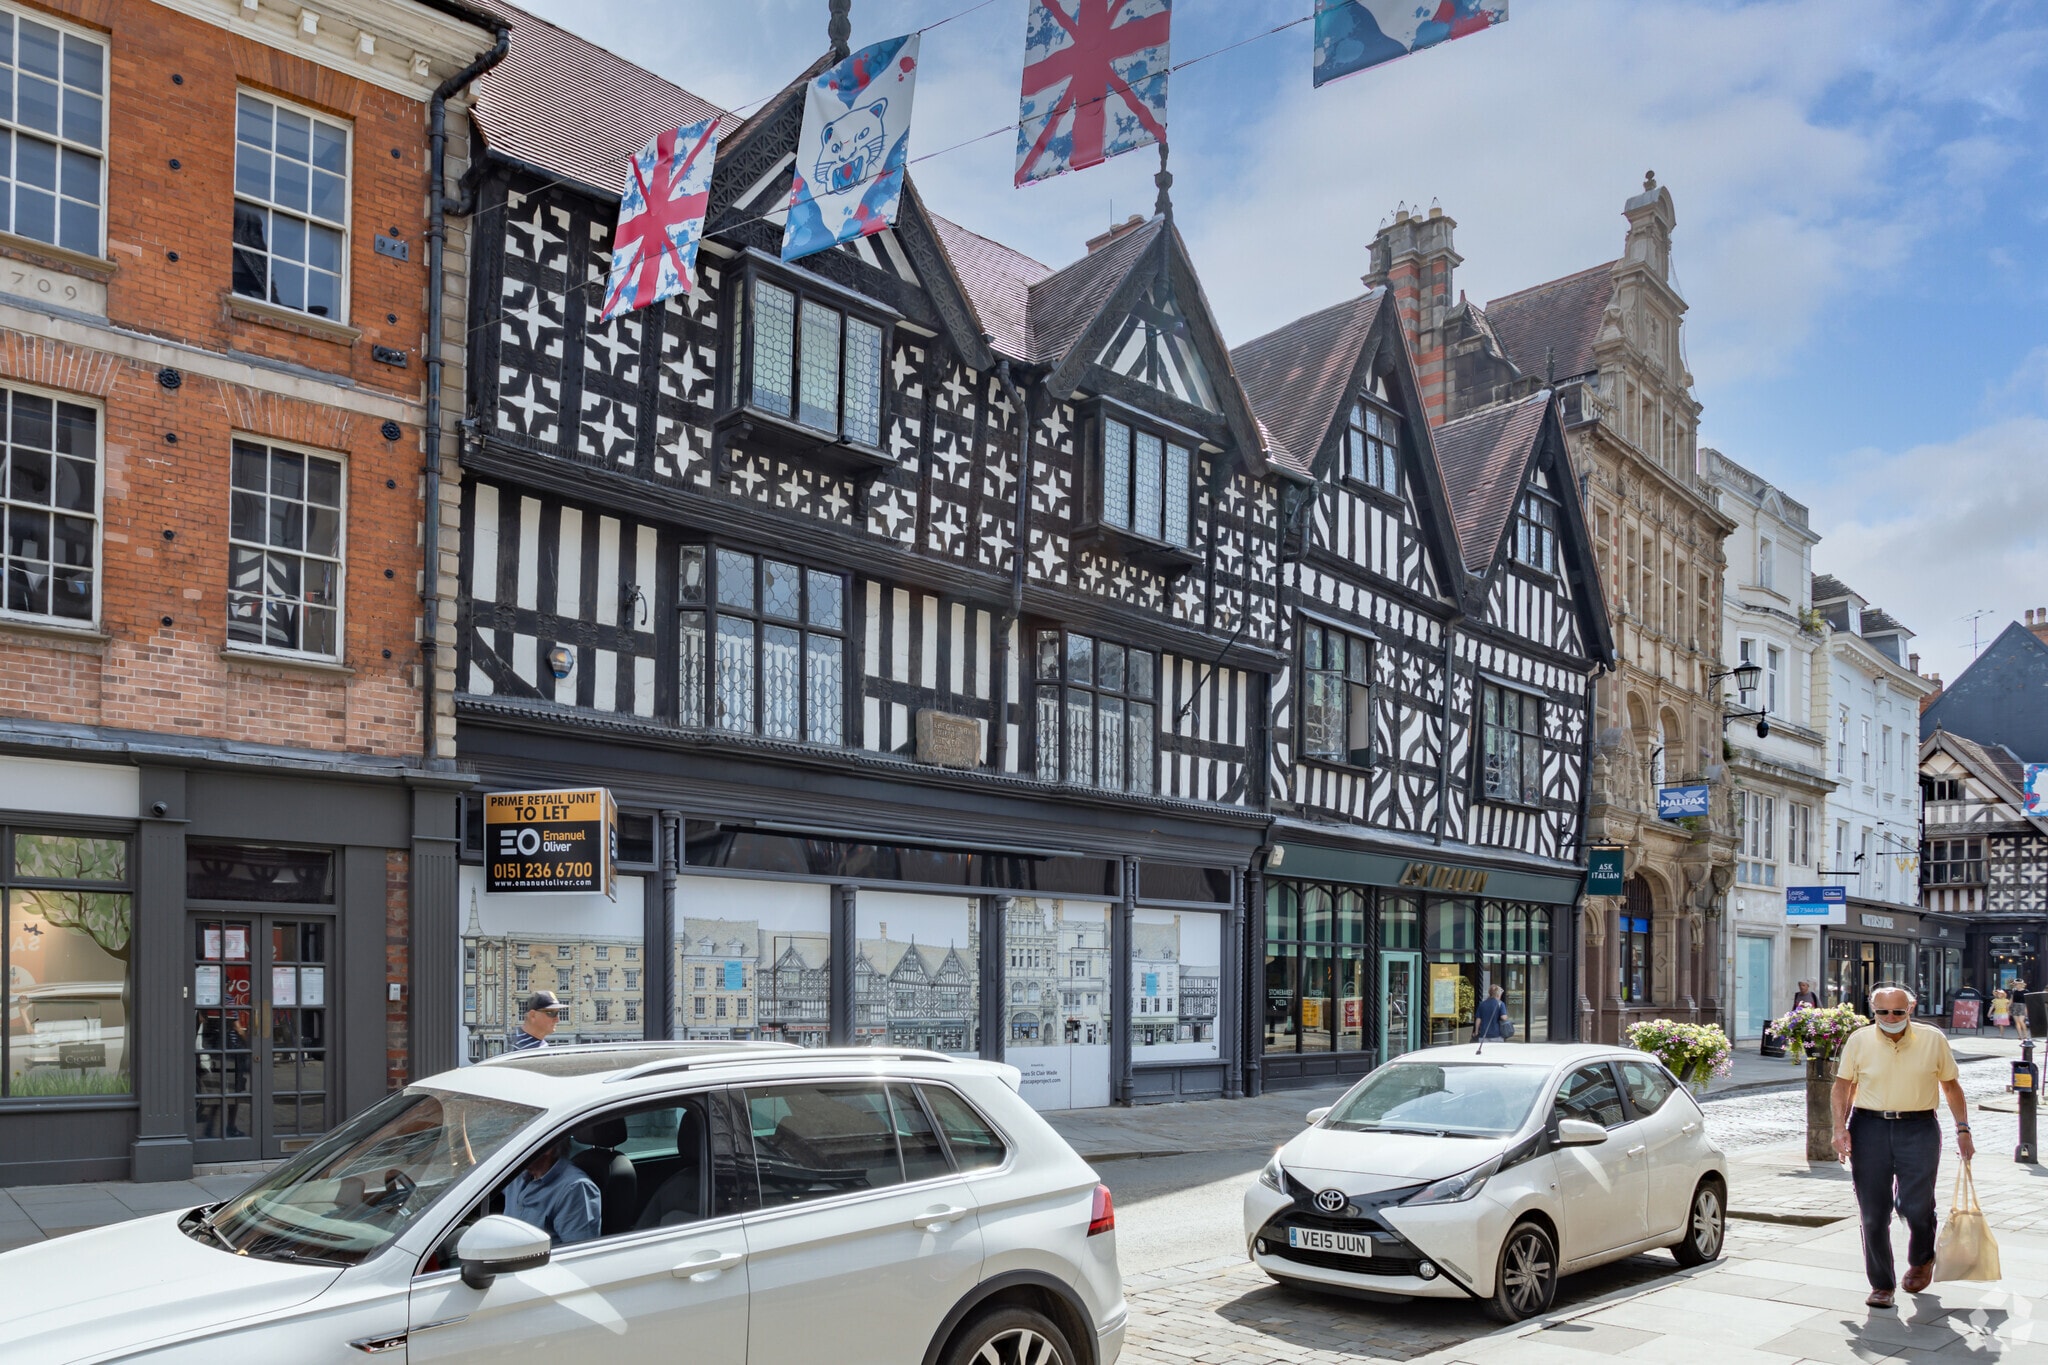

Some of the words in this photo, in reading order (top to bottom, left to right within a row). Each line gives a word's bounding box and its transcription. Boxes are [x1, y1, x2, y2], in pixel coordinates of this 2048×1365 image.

[491, 796, 524, 806] PRIME
[527, 795, 564, 805] RETAIL
[567, 793, 596, 804] UNIT
[1661, 797, 1706, 808] HALIFAX
[515, 806, 537, 821] TO
[543, 805, 570, 820] LET
[543, 829, 586, 841] Emanuel
[543, 841, 572, 852] Oliver
[493, 863, 521, 879] 0151
[525, 862, 552, 878] 236
[556, 861, 592, 878] 6700
[1591, 871, 1620, 879] ITALIAN
[494, 879, 592, 887] www.emanueloliver.com
[1302, 1230, 1333, 1248] VE15
[1337, 1235, 1366, 1253] UUN
